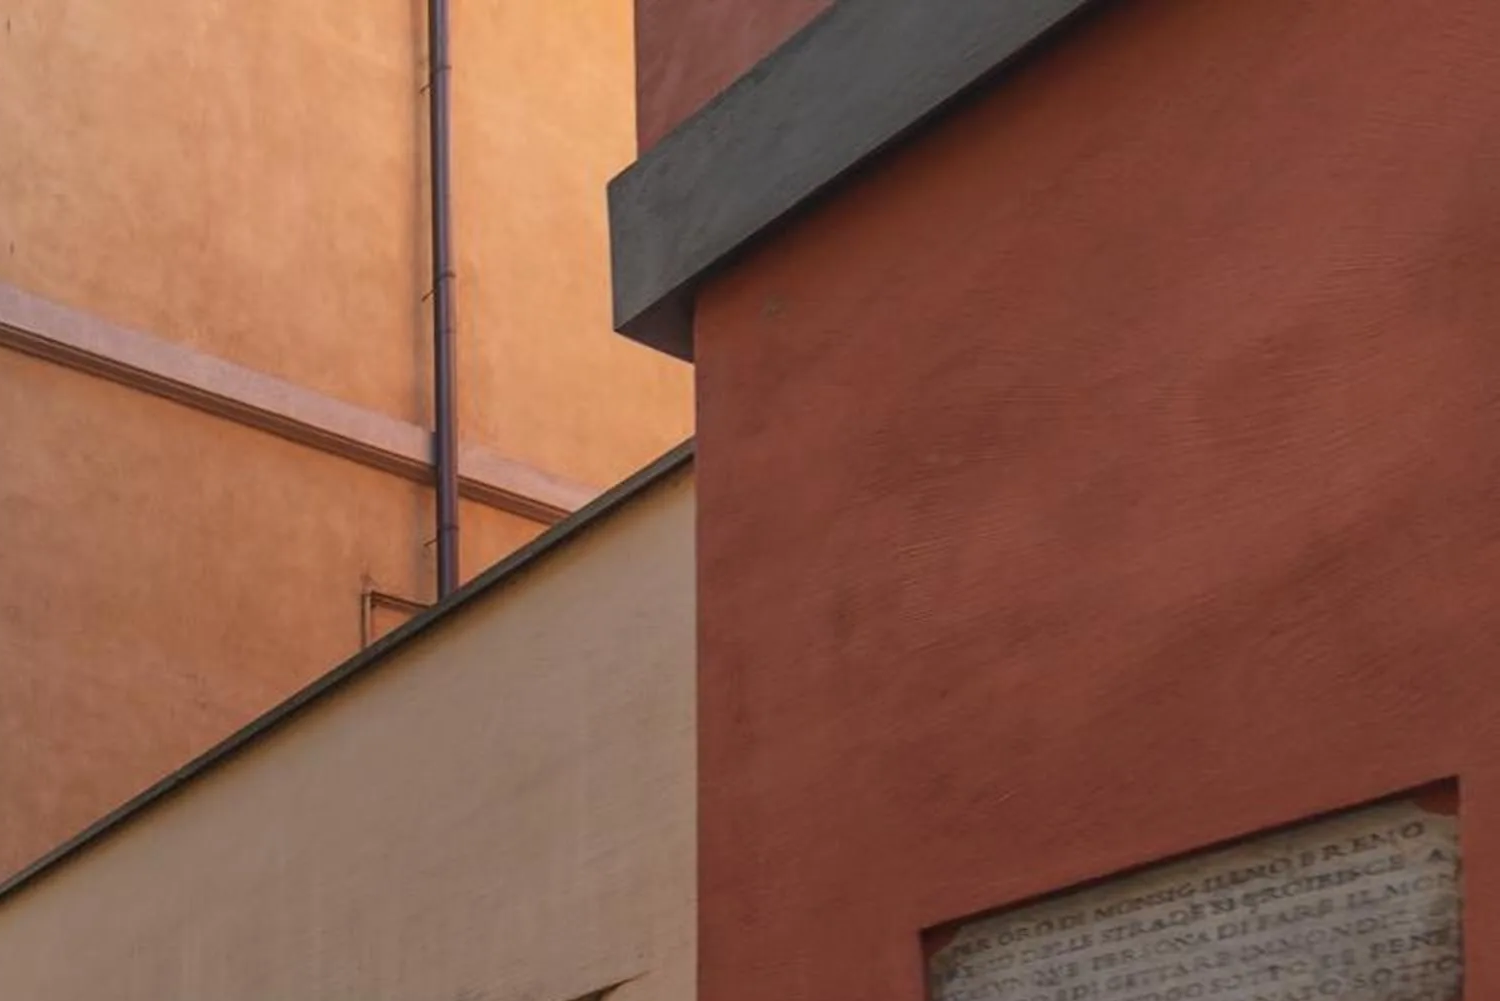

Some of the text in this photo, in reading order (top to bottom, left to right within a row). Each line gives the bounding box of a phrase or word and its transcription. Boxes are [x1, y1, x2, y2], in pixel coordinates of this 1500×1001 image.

[1091, 930, 1211, 970] PERSONA
[1256, 899, 1334, 930] FARE
[1099, 905, 1206, 943] STRADE
